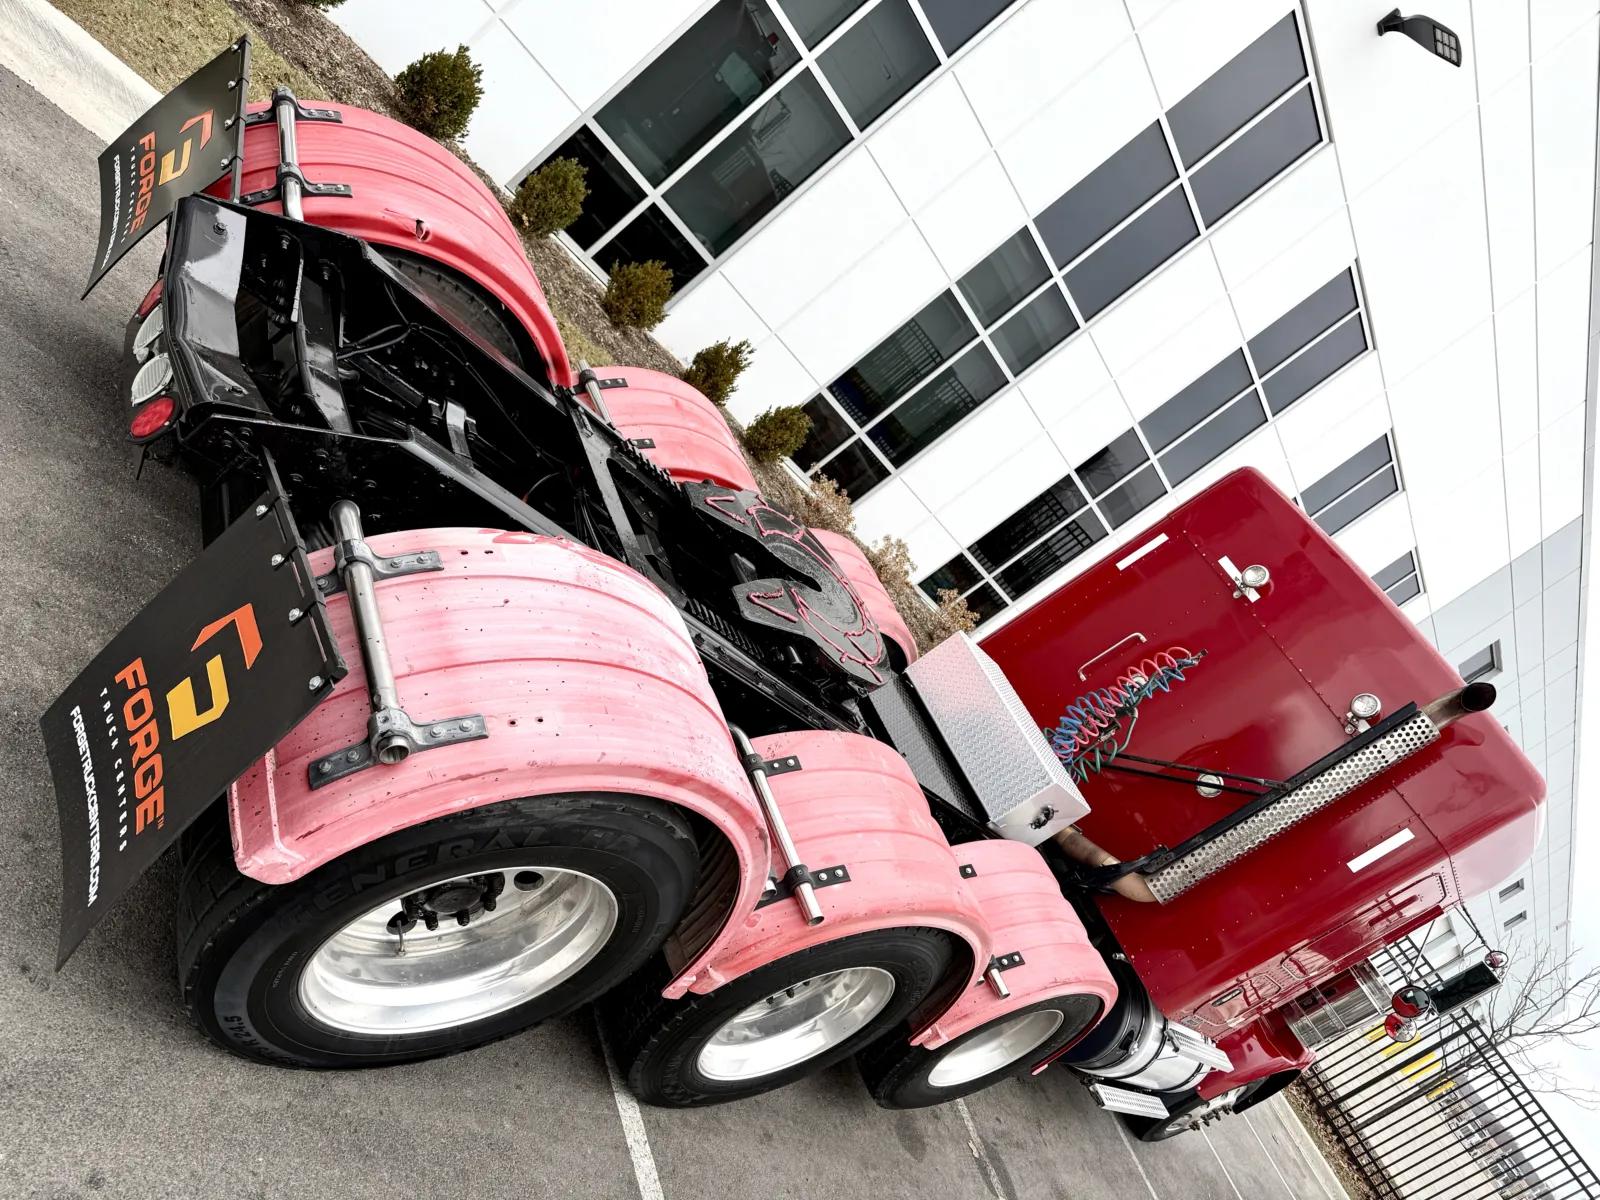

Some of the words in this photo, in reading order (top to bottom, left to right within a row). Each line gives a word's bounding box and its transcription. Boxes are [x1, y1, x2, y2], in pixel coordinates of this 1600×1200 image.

[130, 131, 156, 235] FORGE
[70, 705, 101, 908] FORGETRUCKCENTERS.COM
[100, 687, 119, 750] TRUCK
[114, 758, 128, 852] CENTERS
[115, 656, 165, 835] FORGE
